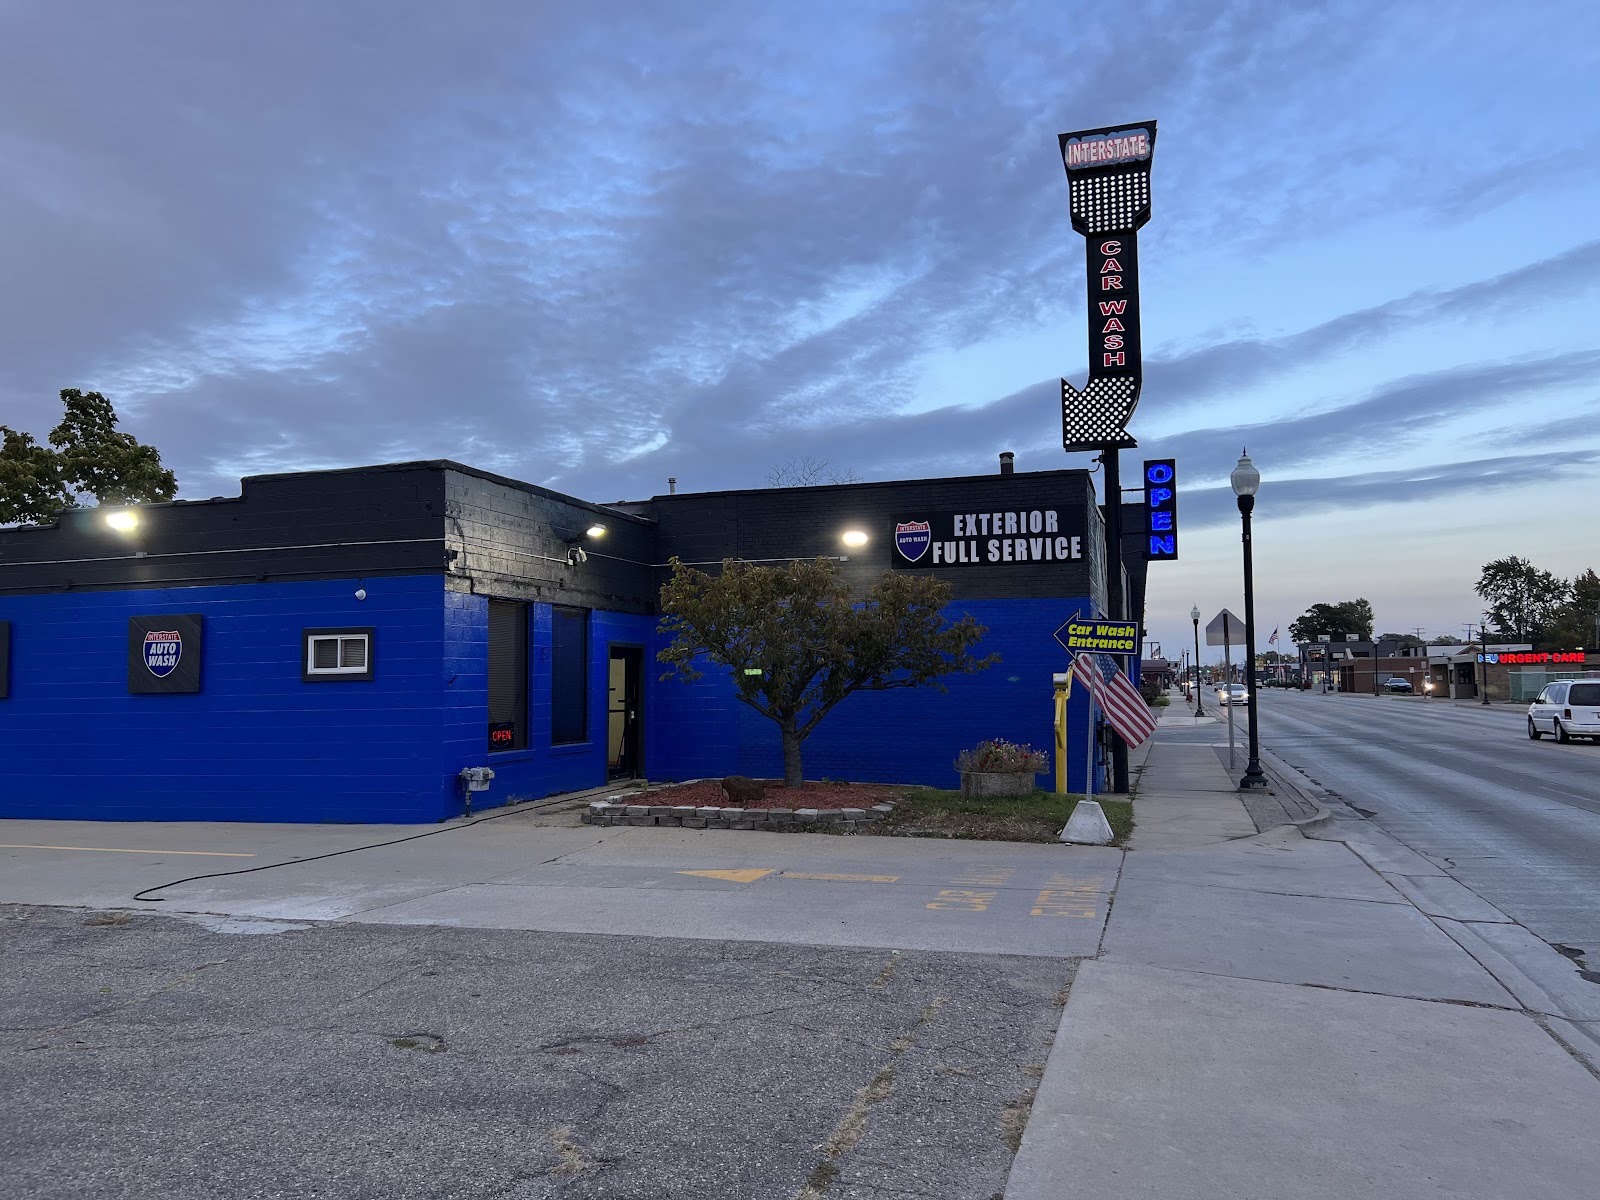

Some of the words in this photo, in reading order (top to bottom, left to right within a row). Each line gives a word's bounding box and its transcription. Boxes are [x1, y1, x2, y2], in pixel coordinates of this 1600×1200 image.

[1068, 134, 1147, 164] INTERSTATE
[1100, 240, 1123, 291] CAR
[1098, 299, 1127, 367] WASH
[1148, 464, 1174, 554] OPEN
[953, 510, 1059, 536] EXTERIOR
[932, 541, 980, 563] FULL
[987, 536, 1082, 562] SERVICE
[1068, 623, 1093, 635] Car
[1096, 625, 1135, 637] Wash
[150, 643, 176, 654] AUTO
[1067, 636, 1134, 649] Entrance
[149, 655, 176, 666] WASH
[1499, 653, 1549, 664] URGENT
[1552, 652, 1585, 663] CARE
[493, 730, 511, 741] OPEN
